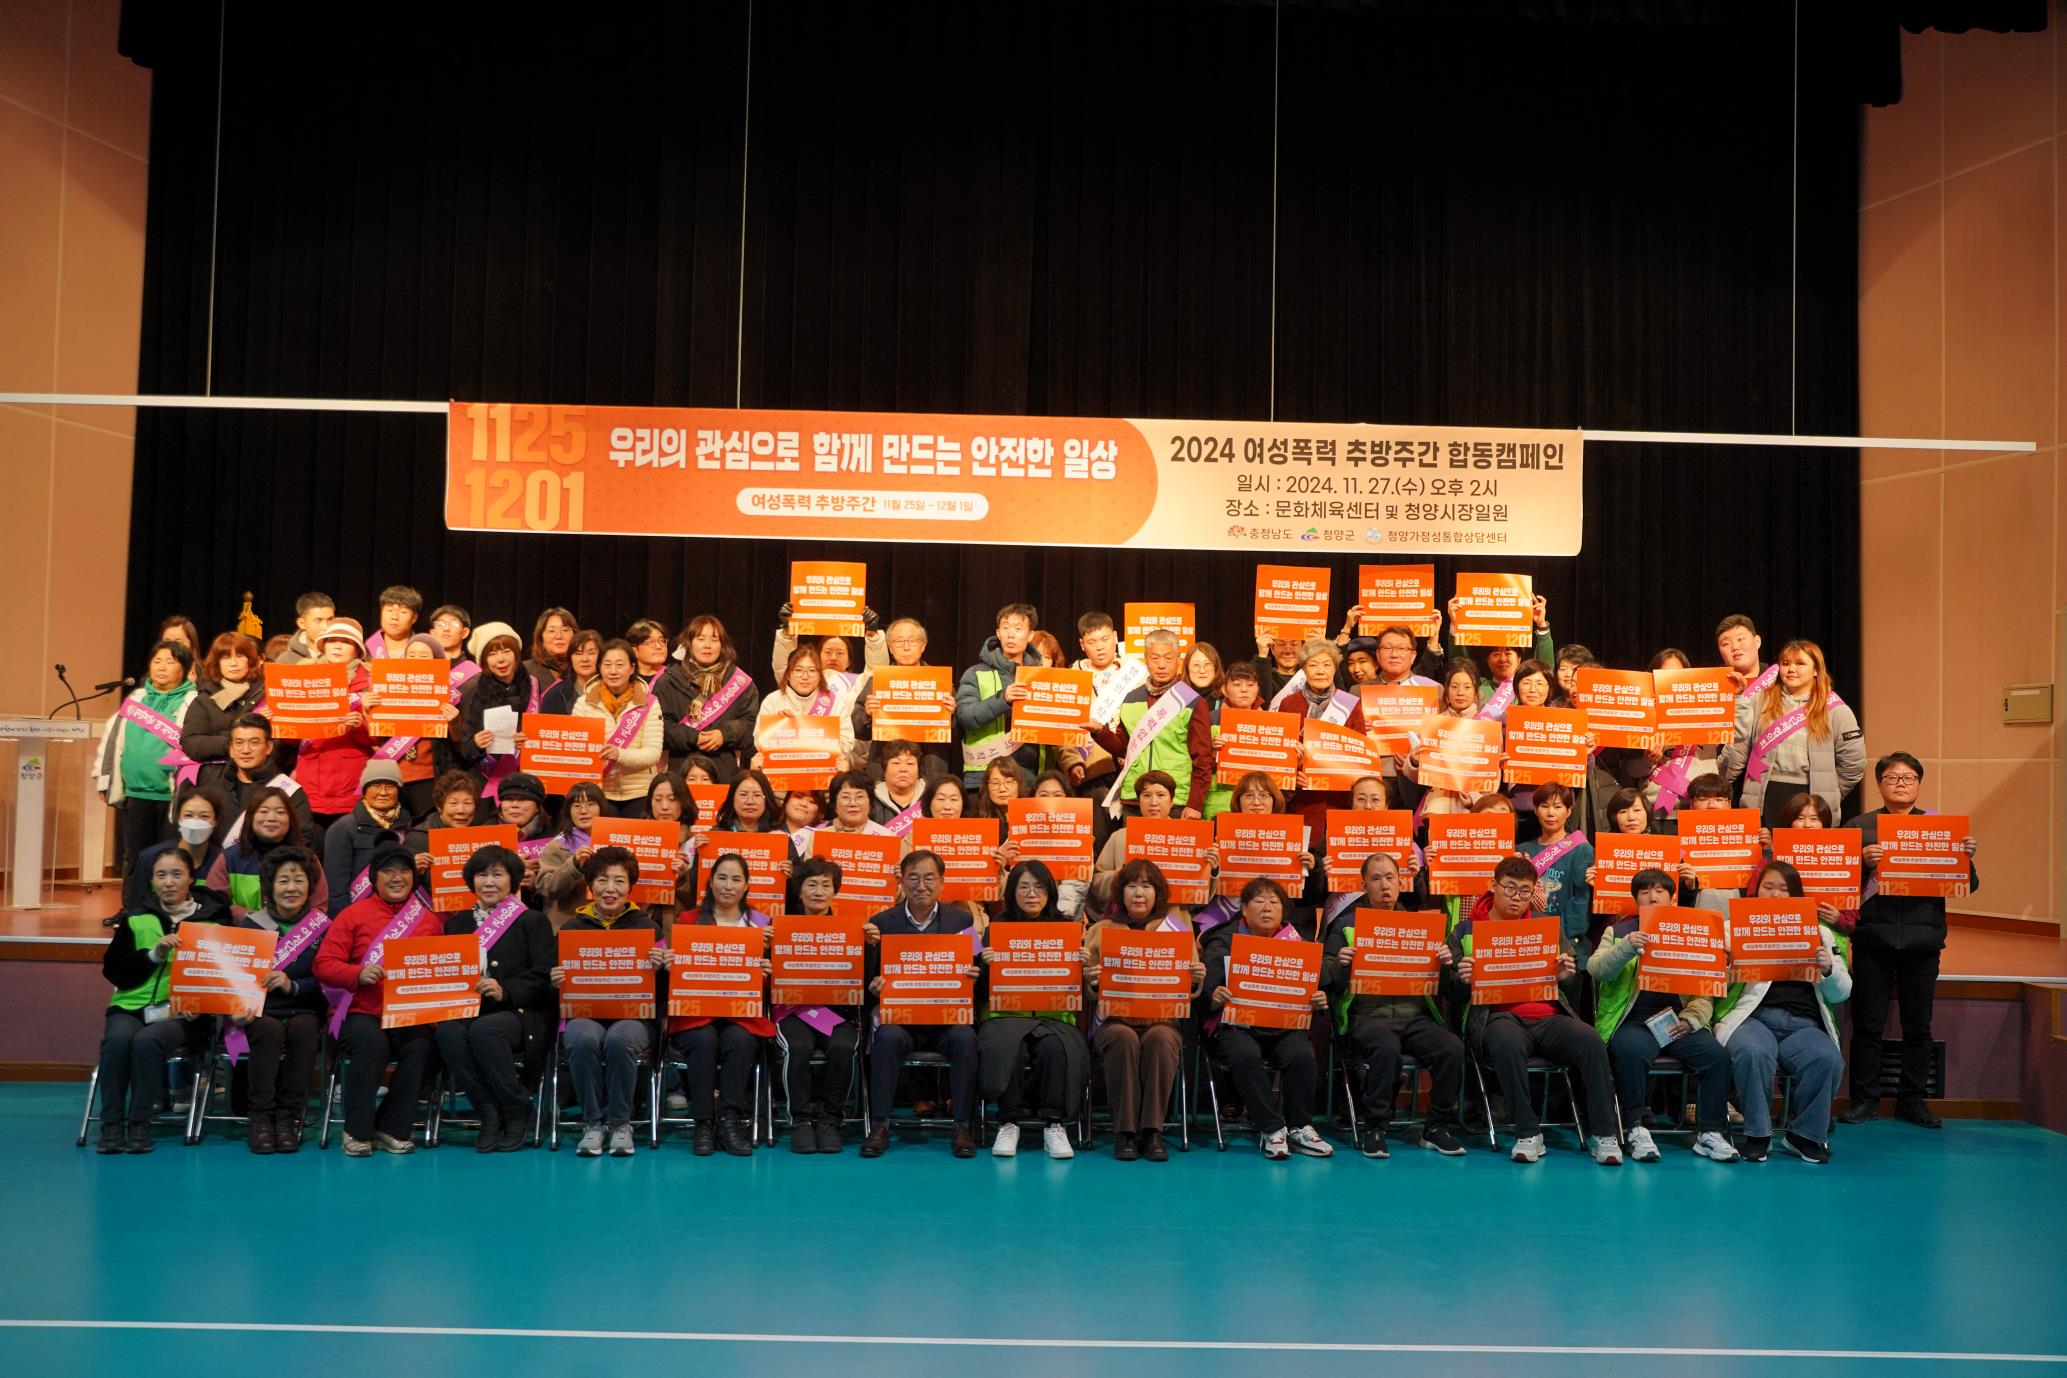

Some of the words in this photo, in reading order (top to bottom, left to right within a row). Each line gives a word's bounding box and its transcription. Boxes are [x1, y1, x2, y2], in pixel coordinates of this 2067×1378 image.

[468, 403, 586, 464] 1125
[609, 427, 687, 468] 우리의
[696, 429, 800, 471] 관심으로
[813, 432, 872, 473] 함께
[882, 433, 961, 476] 만드는
[970, 435, 1054, 478] 안전한
[1063, 439, 1118, 480] 일상
[1170, 436, 1235, 463] 2024
[1244, 437, 1336, 467] 여성폭력
[1346, 439, 1440, 468] 추방주간
[1448, 441, 1564, 470] 합동캠페인
[1237, 474, 1270, 493] 일시
[1430, 478, 1464, 496] 오후
[1470, 479, 1497, 496] 2시
[465, 468, 584, 531] 1201
[751, 494, 811, 511] 여성폭력
[815, 495, 876, 512] 추방주간
[884, 499, 900, 510] 11월
[903, 500, 925, 511] 25일
[936, 500, 957, 511] 12월
[1226, 500, 1260, 517] 장소
[1275, 500, 1379, 520] 문화체육센터
[1386, 505, 1398, 520] 및
[1405, 503, 1508, 521] 청양시장일원
[1250, 528, 1293, 540] 충청남도
[1323, 529, 1355, 541] 청양군
[1388, 530, 1507, 543] 청양가정성통합상담센터
